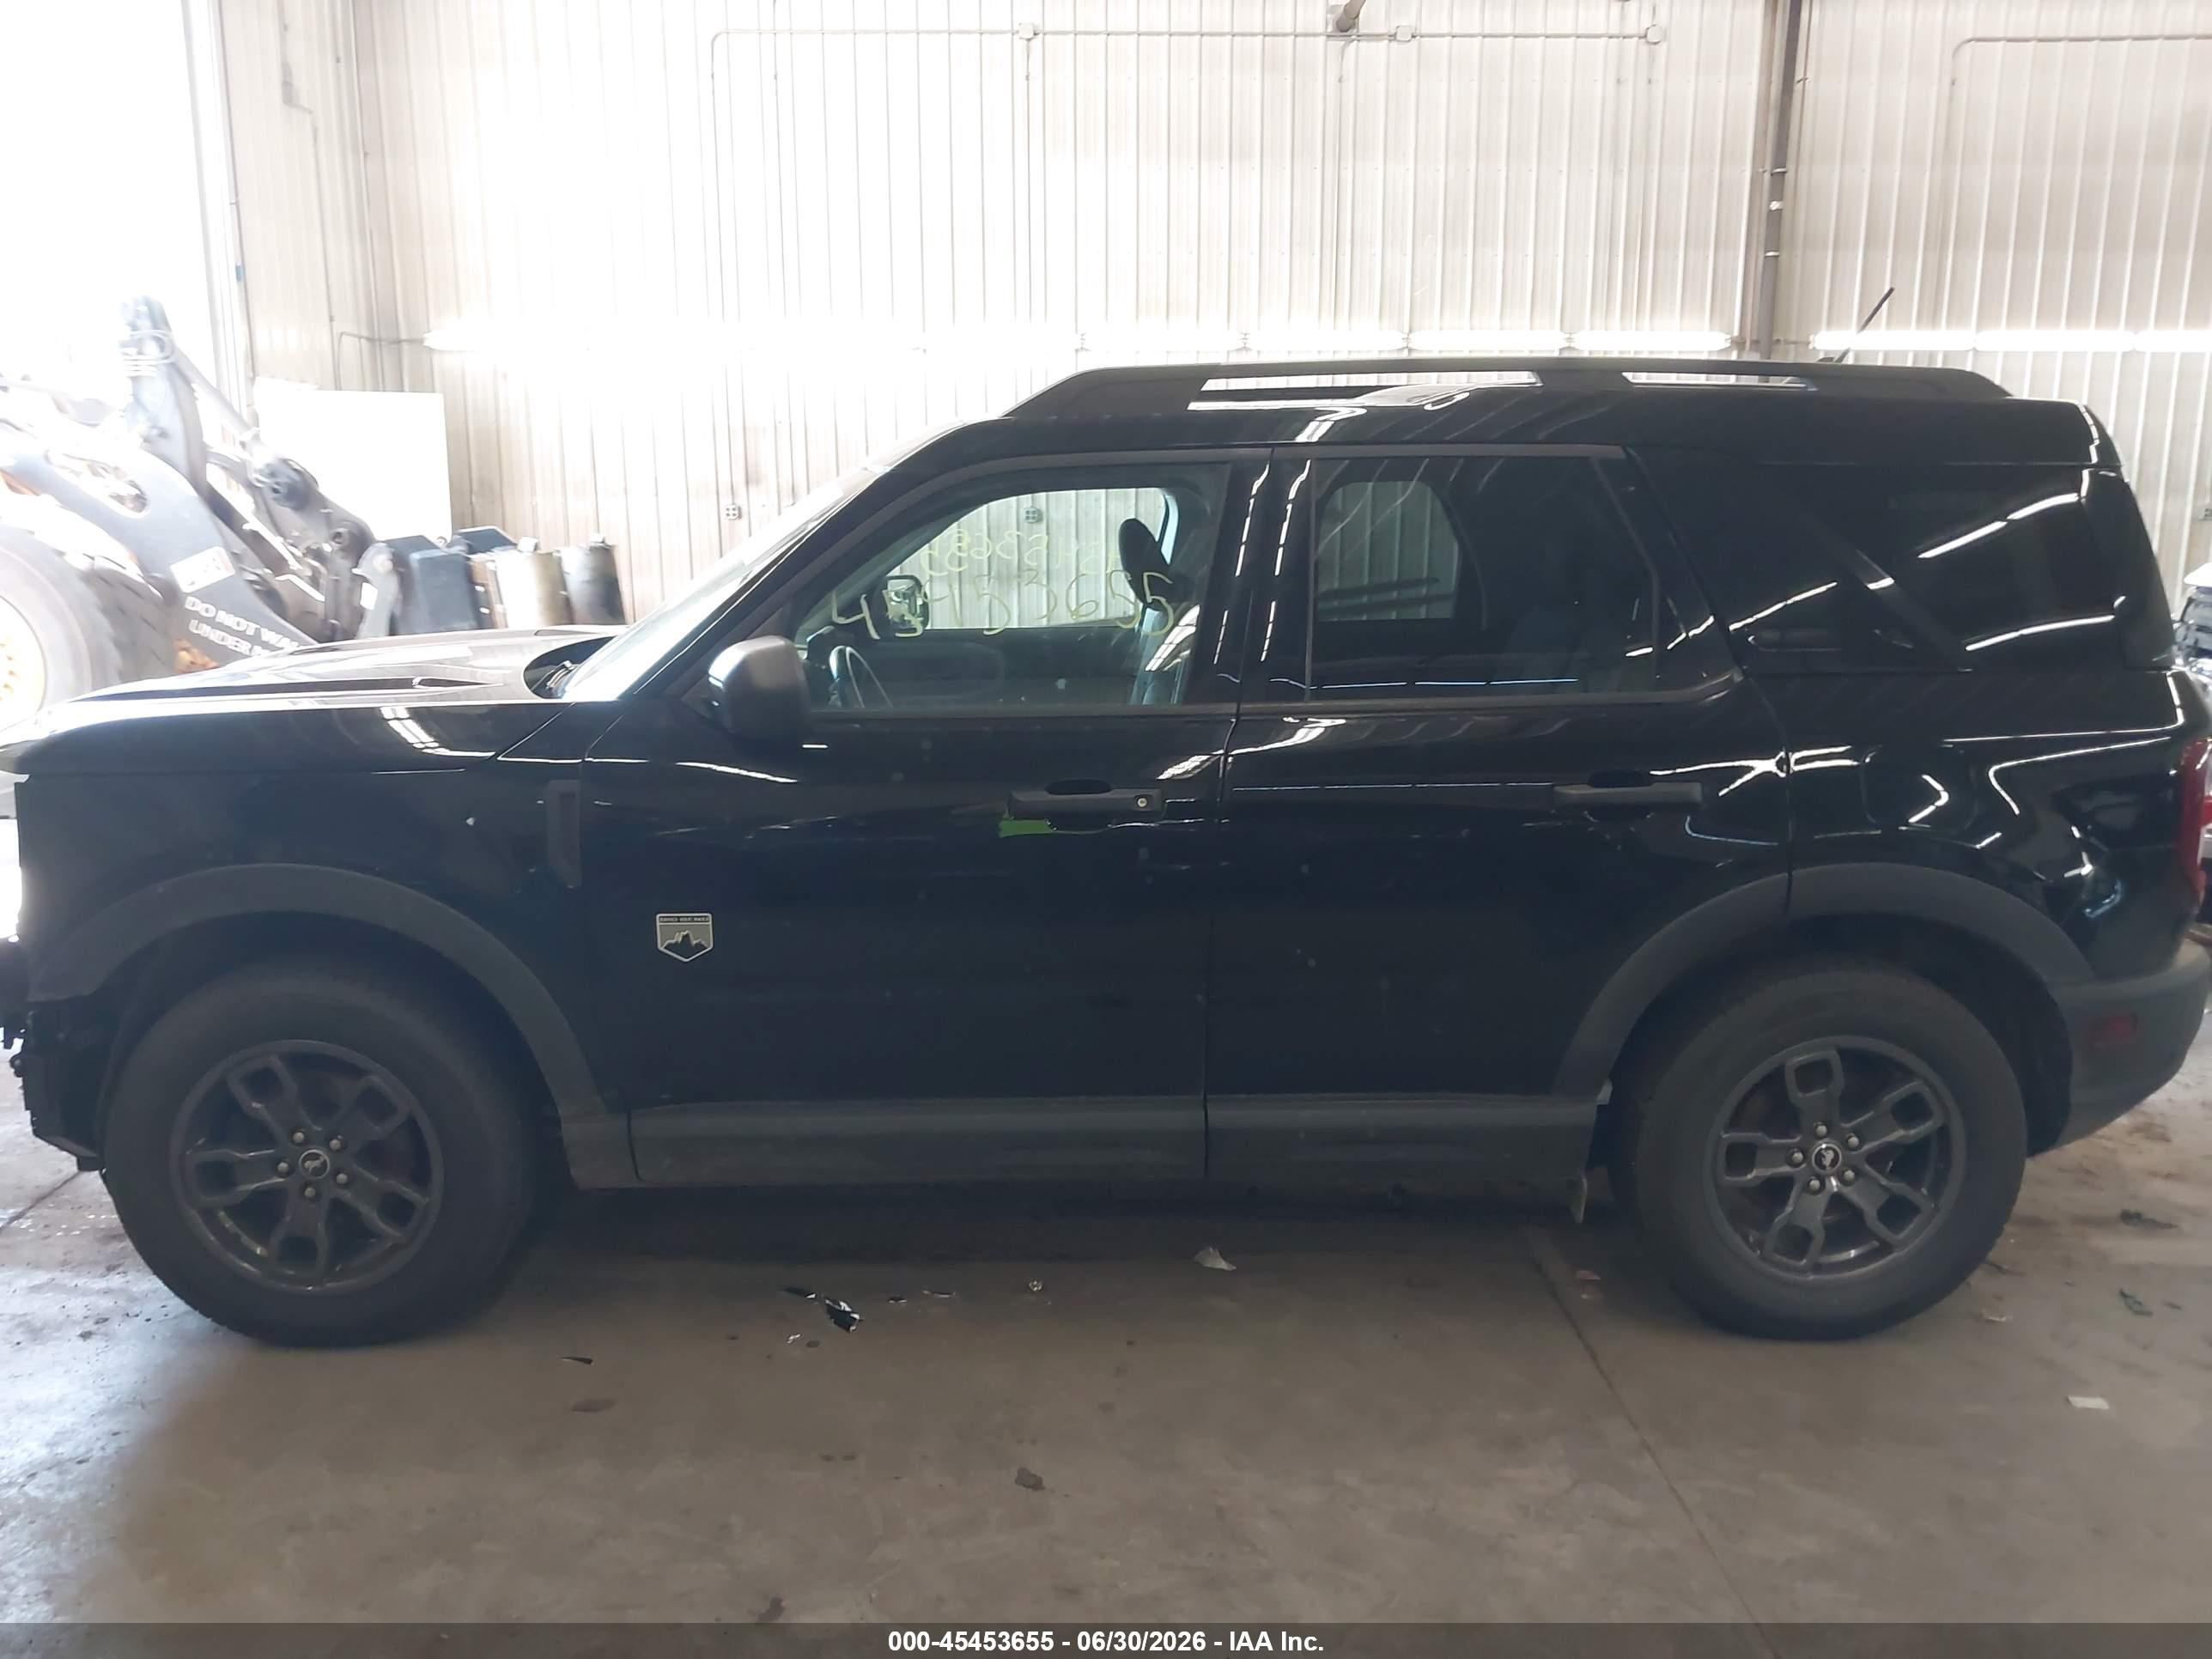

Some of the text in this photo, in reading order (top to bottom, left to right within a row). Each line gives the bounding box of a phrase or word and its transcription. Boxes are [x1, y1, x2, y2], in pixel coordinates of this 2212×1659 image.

[185, 596, 300, 650] DO NOT WA
[831, 568, 1174, 641] 45453655
[188, 619, 252, 656] UNDER
